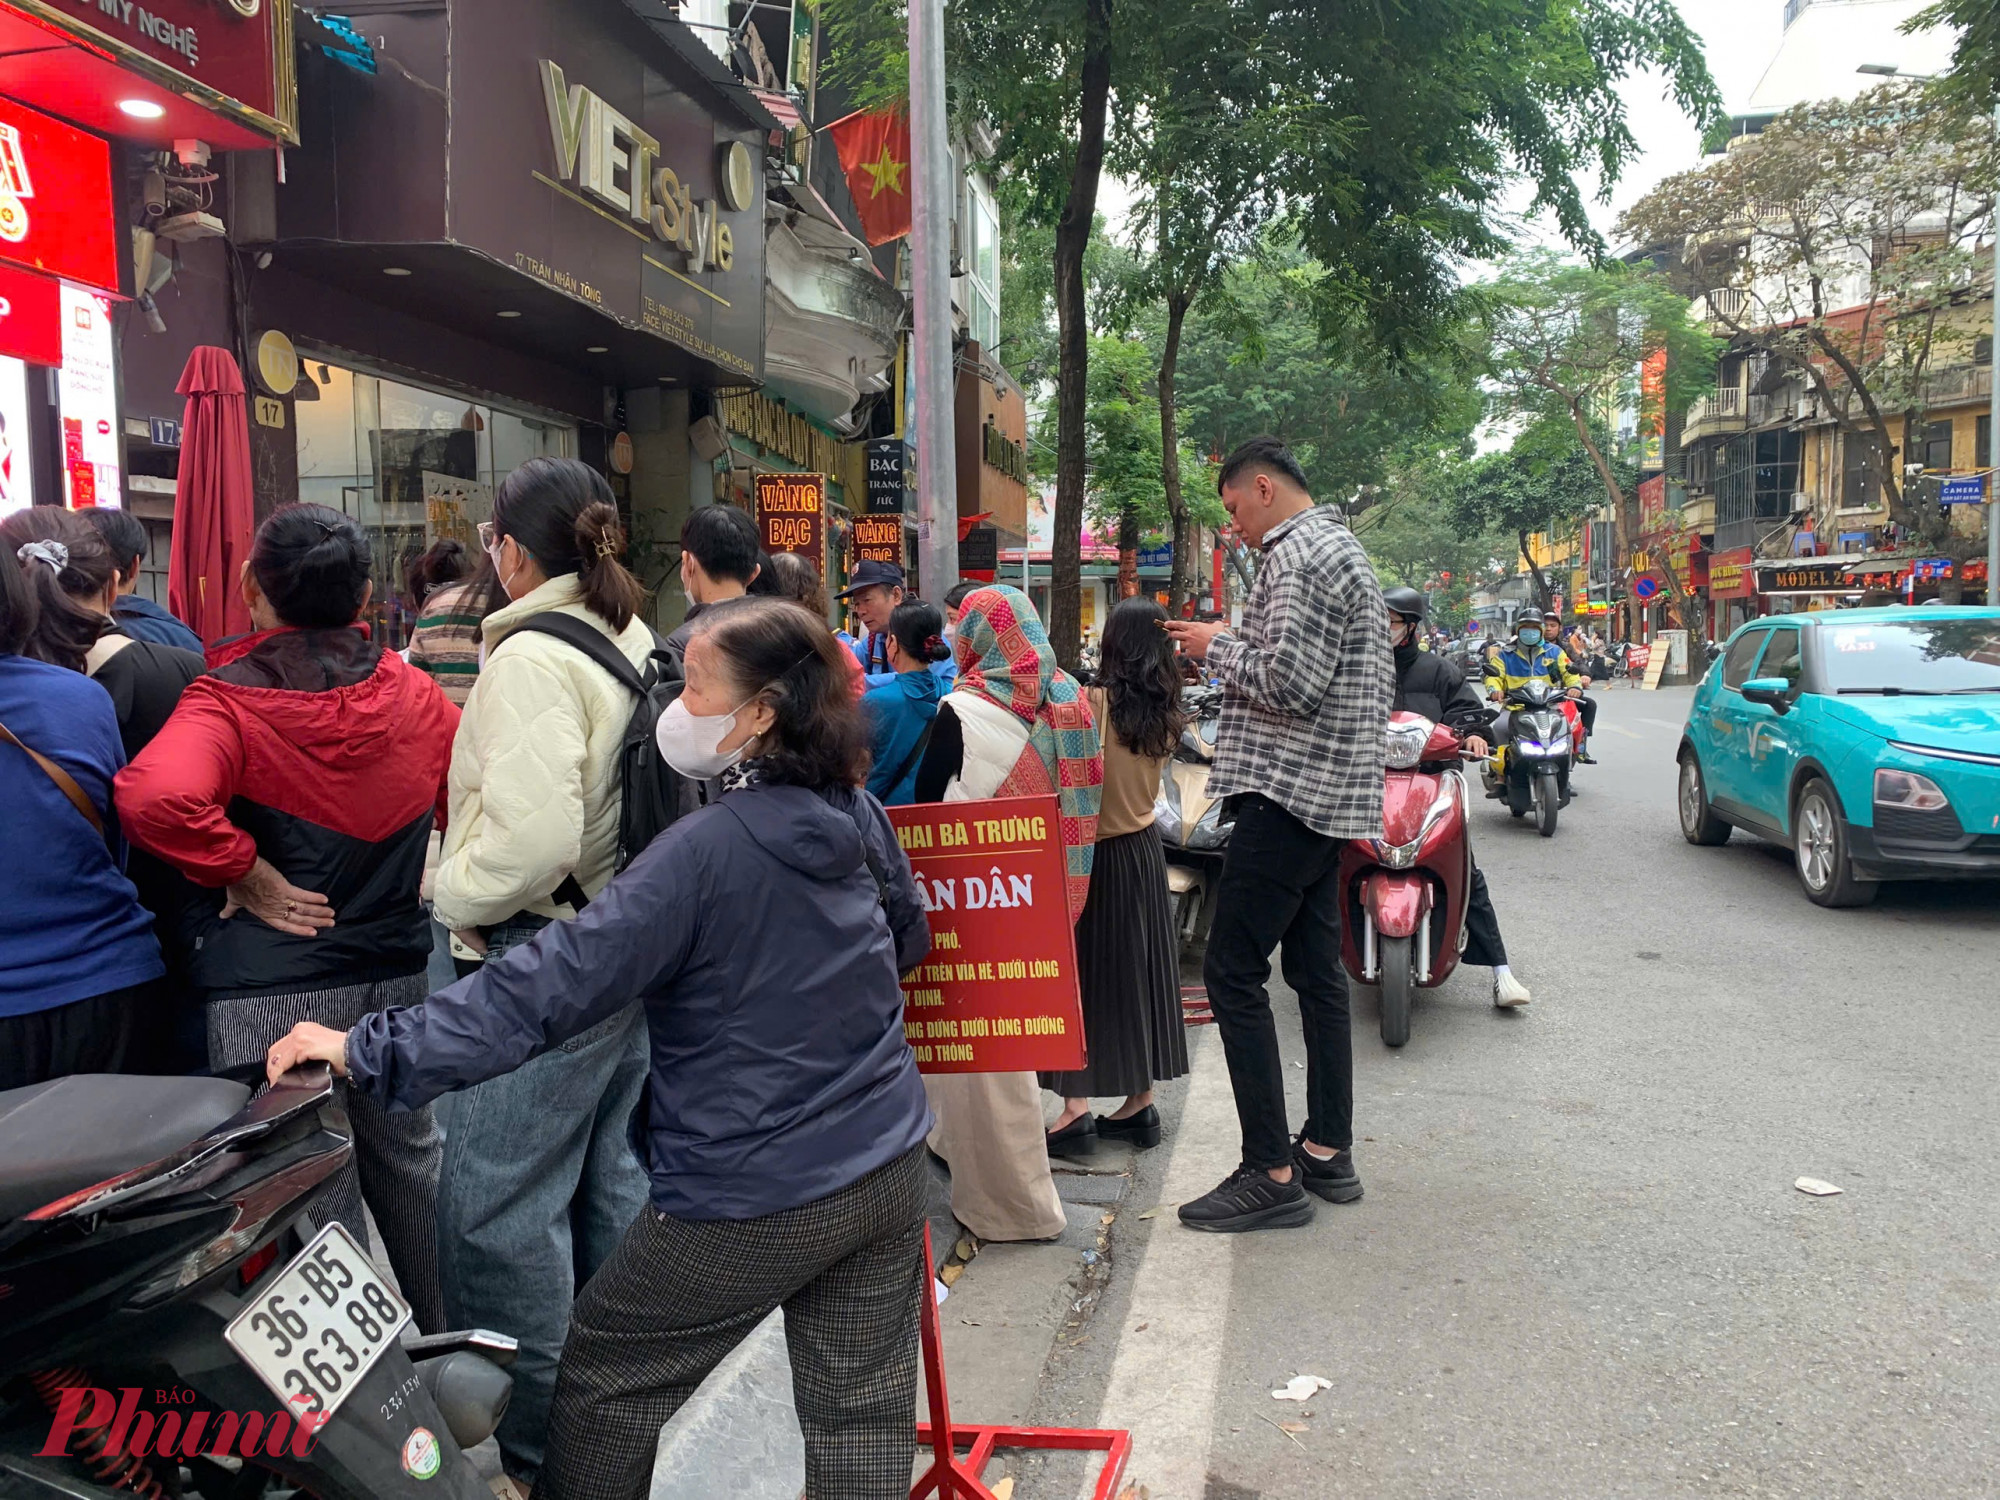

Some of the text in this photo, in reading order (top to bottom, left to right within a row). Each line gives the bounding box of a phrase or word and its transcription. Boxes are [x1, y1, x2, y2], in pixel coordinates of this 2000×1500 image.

[138, 7, 199, 67] NGHỆ
[515, 252, 524, 267] 17
[554, 272, 577, 293] NHÂN
[580, 281, 601, 303] TÔNG
[262, 402, 279, 423] 17
[157, 421, 174, 444] 17
[870, 459, 899, 475] BẠC
[761, 479, 818, 512] VÀNG
[869, 480, 901, 489] TRANG
[1943, 486, 1980, 494] CAMERA
[769, 518, 811, 552] BẠC
[855, 519, 897, 544] VÀNG
[1775, 570, 1846, 587] MODEL 2
[897, 815, 1047, 849] HAI BÀ TRƯNG
[914, 866, 1033, 912] ÂN DÂN
[925, 961, 954, 982] TRÊN
[978, 960, 996, 982] HÈ,
[998, 959, 1027, 980] DƯỚI
[1029, 958, 1059, 978] LÒNG
[926, 1018, 958, 1039] ĐỨNG
[961, 1016, 989, 1037] DƯỚI
[992, 1016, 1022, 1036] LÒNG
[1025, 1015, 1066, 1036] ĐƯỜNG
[913, 1041, 974, 1063] IAO THÔNG
[251, 1242, 354, 1358] 36-B5
[284, 1282, 398, 1415] 363.88
